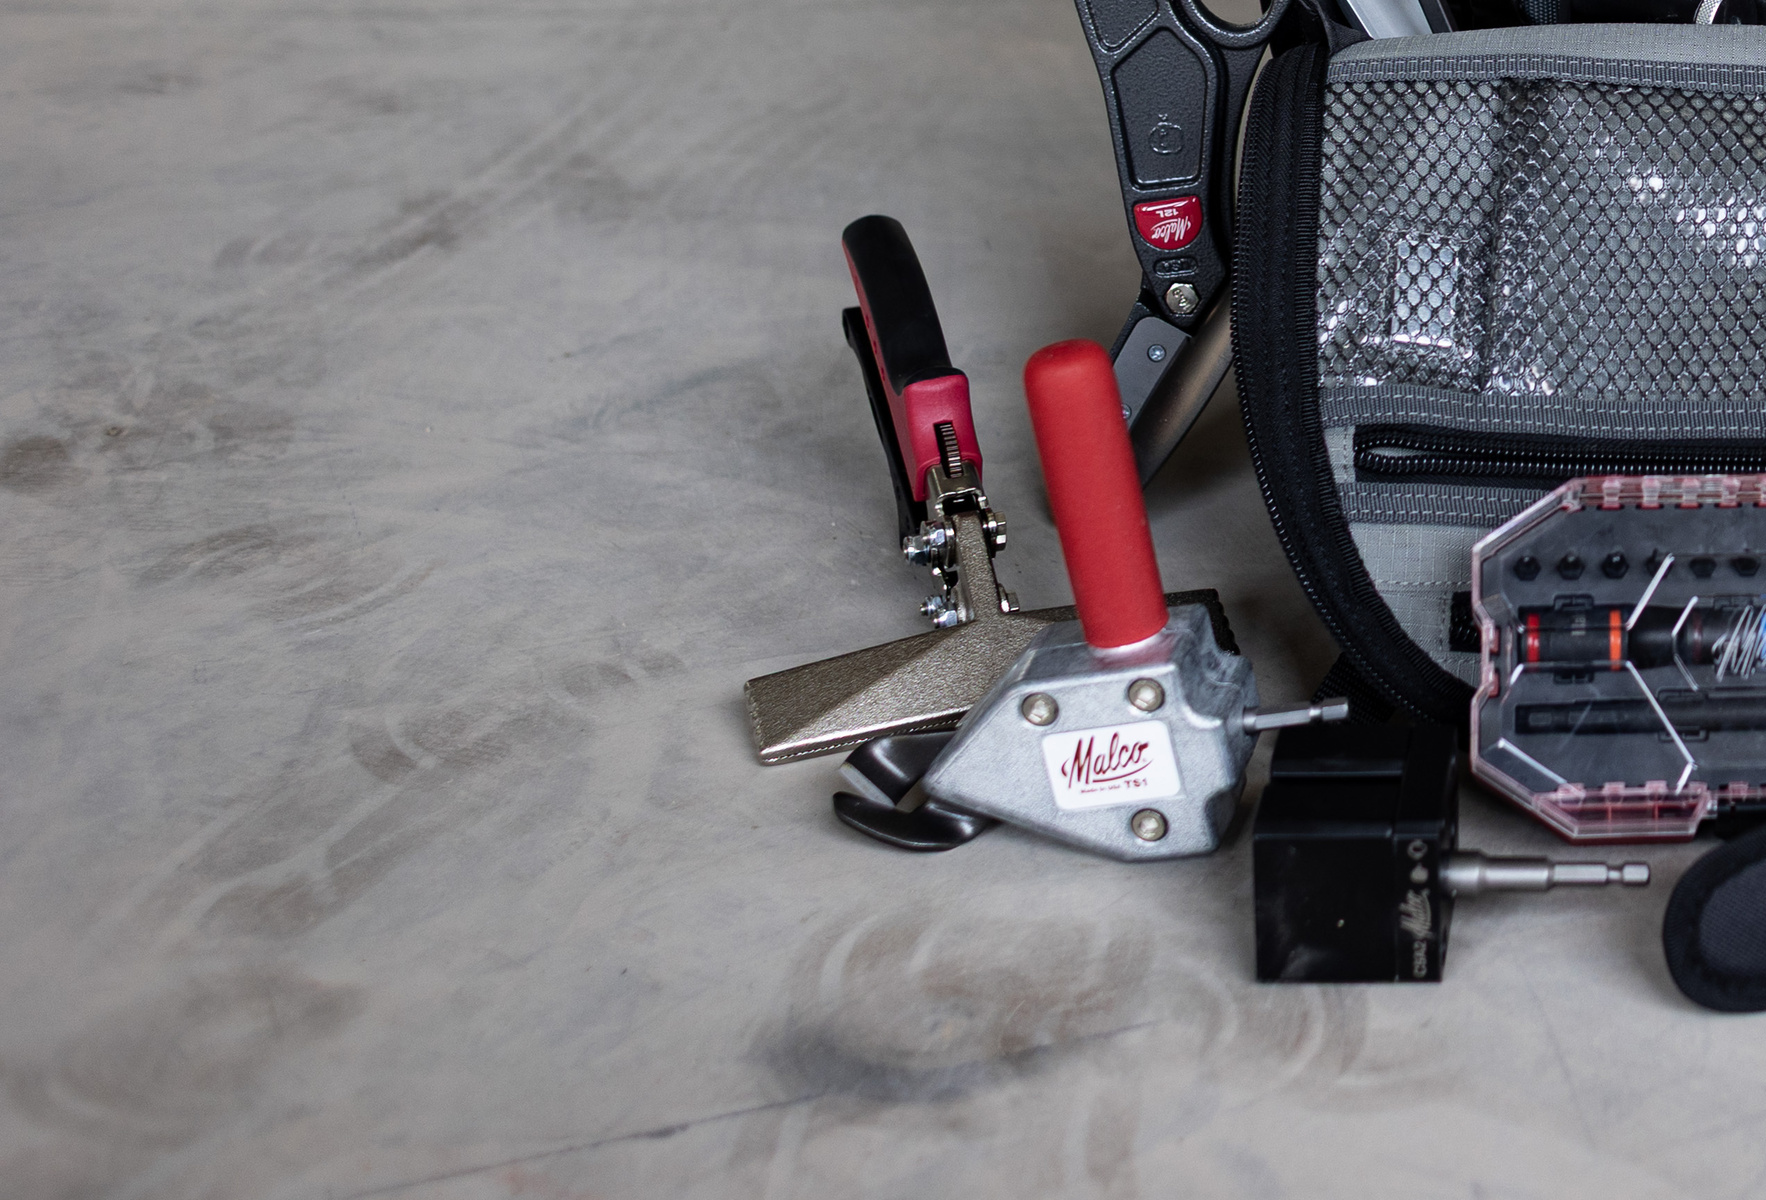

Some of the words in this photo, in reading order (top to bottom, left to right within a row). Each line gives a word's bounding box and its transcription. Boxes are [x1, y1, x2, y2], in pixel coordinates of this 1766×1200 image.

[1155, 208, 1179, 218] 12L
[1150, 216, 1192, 243] Malco
[1061, 731, 1154, 789] Malco
[1124, 777, 1148, 788] TS1
